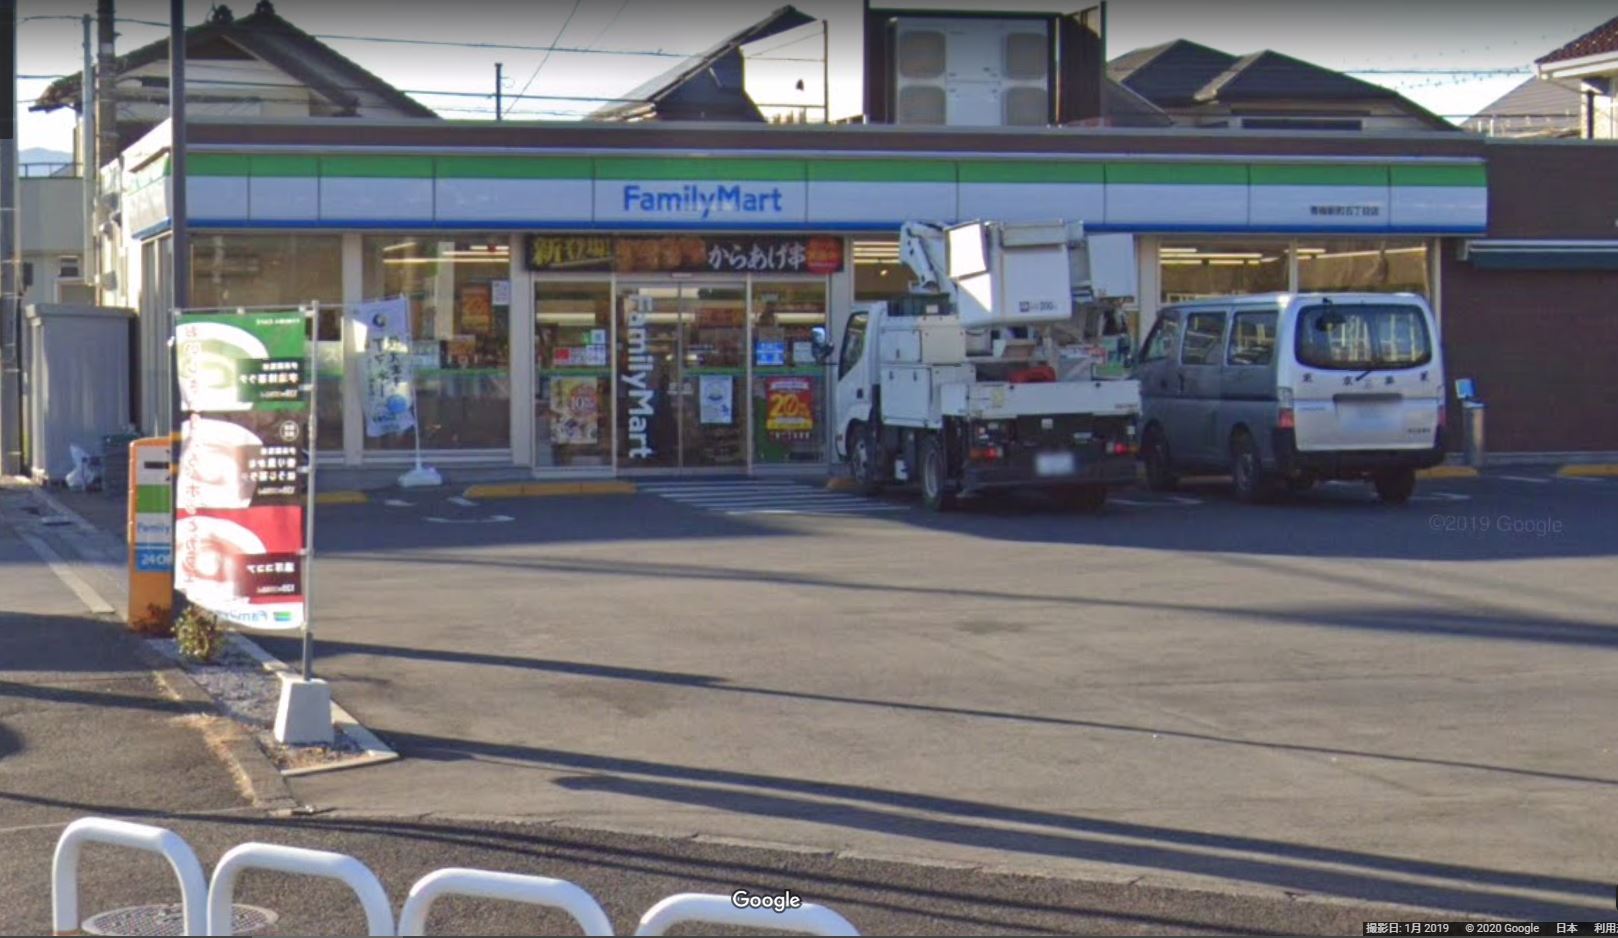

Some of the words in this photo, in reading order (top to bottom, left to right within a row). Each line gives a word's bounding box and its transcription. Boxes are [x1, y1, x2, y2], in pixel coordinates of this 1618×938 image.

[623, 184, 783, 219] FamilyMart
[708, 243, 806, 270] からあげ串
[621, 294, 655, 459] FamilyMart
